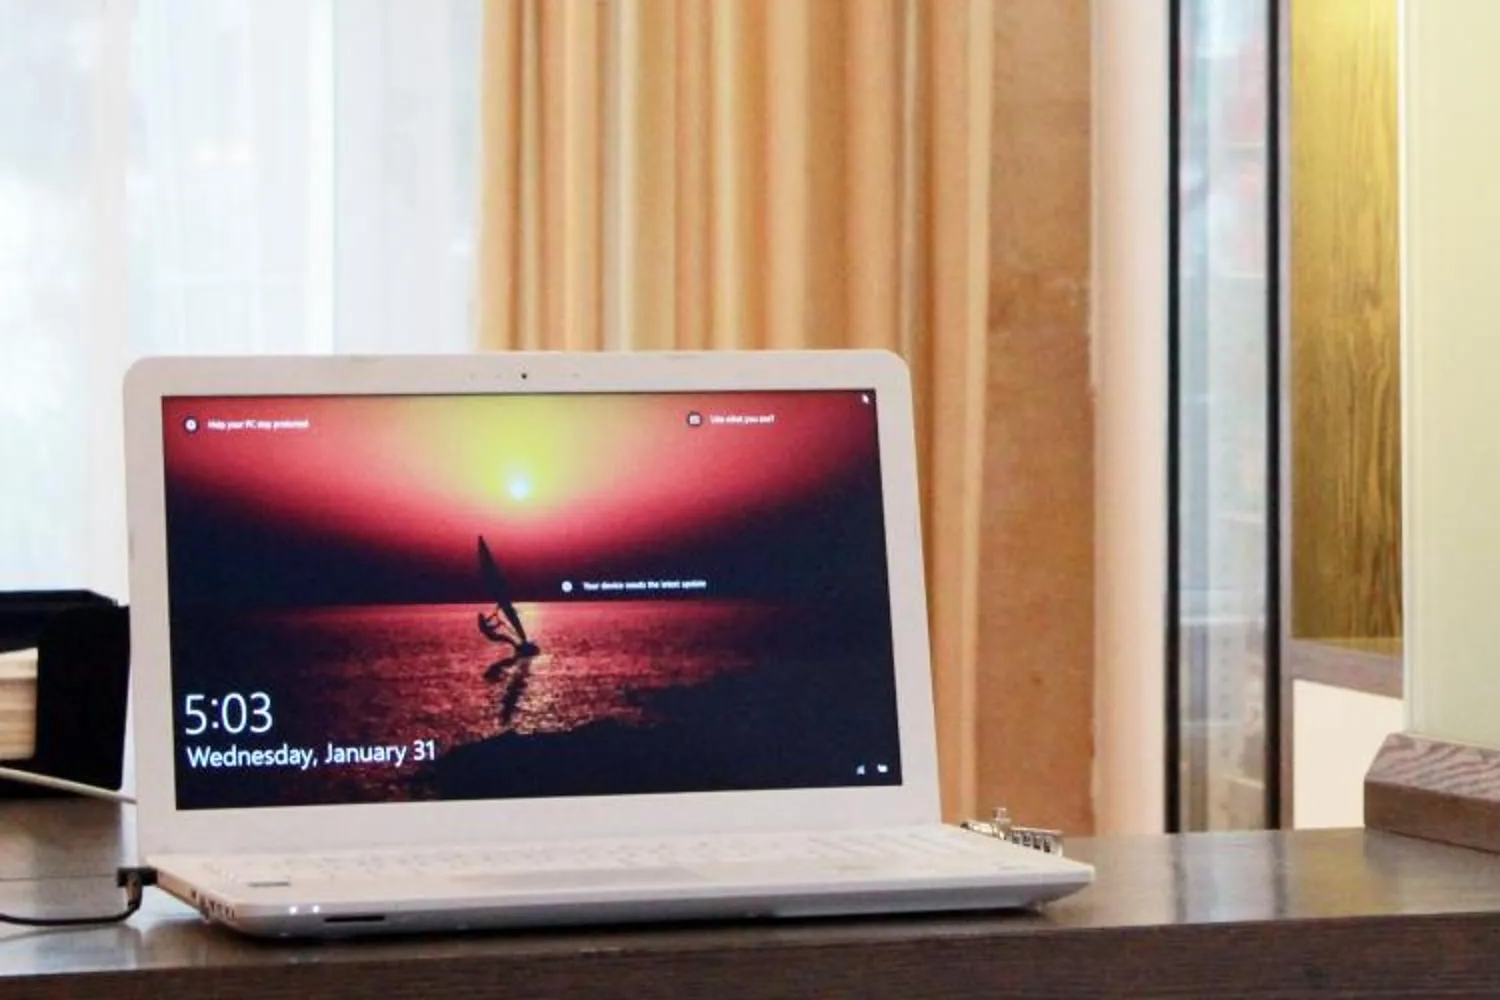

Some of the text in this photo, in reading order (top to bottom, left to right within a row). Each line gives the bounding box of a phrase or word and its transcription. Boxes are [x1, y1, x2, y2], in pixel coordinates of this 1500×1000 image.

[207, 418, 226, 431] Help
[227, 420, 245, 432] your
[246, 418, 257, 429] PC
[582, 579, 707, 591] Your device needs the latest update
[184, 692, 273, 735] 5:03
[187, 739, 436, 770] Wednesday, January 31
